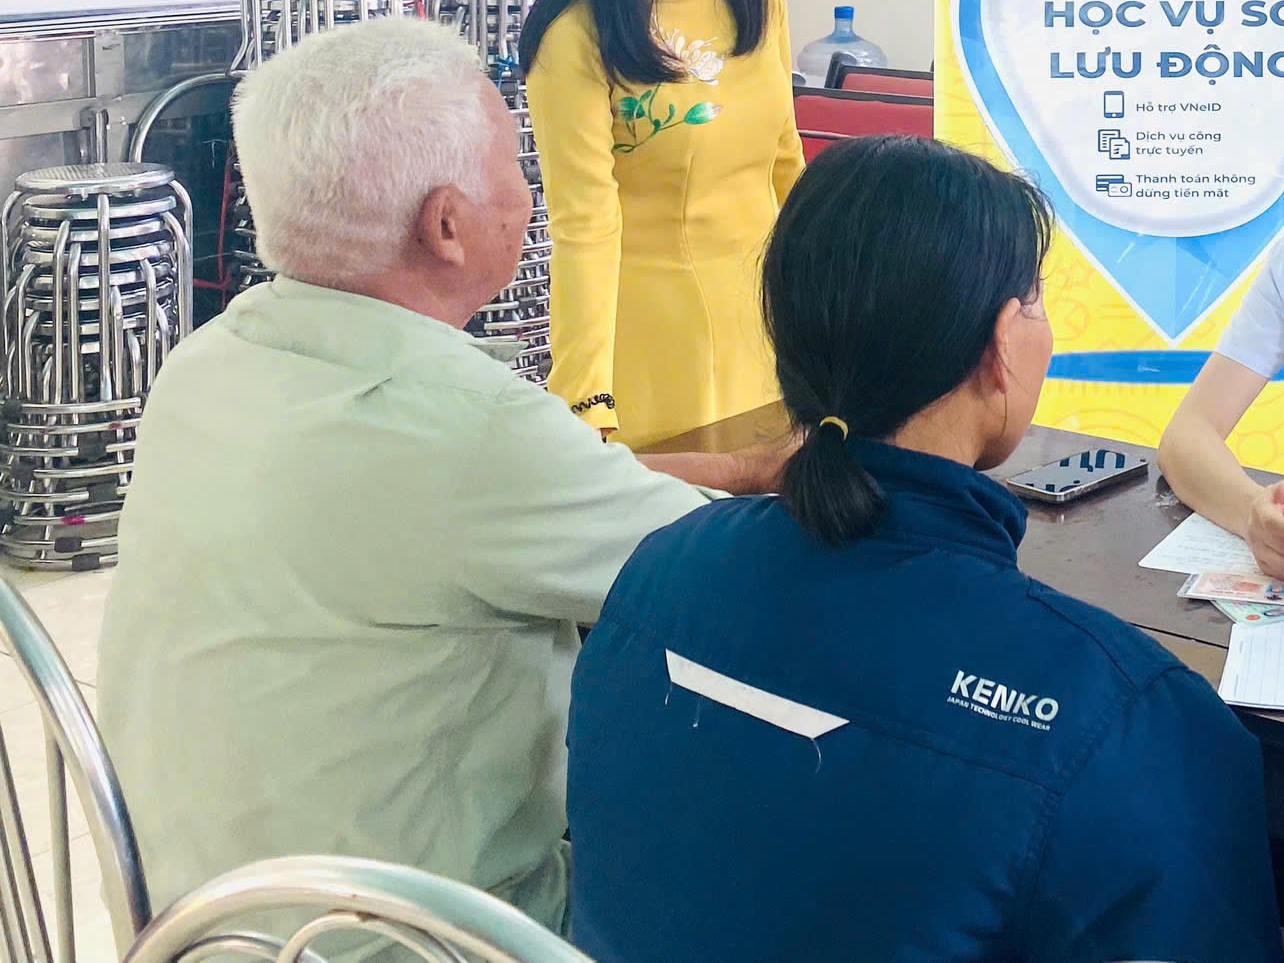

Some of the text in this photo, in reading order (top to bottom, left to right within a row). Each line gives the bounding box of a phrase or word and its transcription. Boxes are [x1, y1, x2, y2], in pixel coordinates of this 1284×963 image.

[1044, 0, 1147, 35] HỌC
[1159, 0, 1225, 35] VỤ
[1049, 46, 1142, 78] LƯU
[1136, 101, 1221, 114] Hỗ trợ VNeID
[1136, 130, 1221, 143] Dịch vụ công
[1136, 144, 1203, 157] trực tuyến
[1136, 173, 1256, 185] Thanh toán không
[1136, 188, 1229, 199] dùng tiền mặt
[950, 669, 1059, 722] KENKO
[947, 696, 1050, 731] JAPAN TECHNOLOGY COOL WEAR
